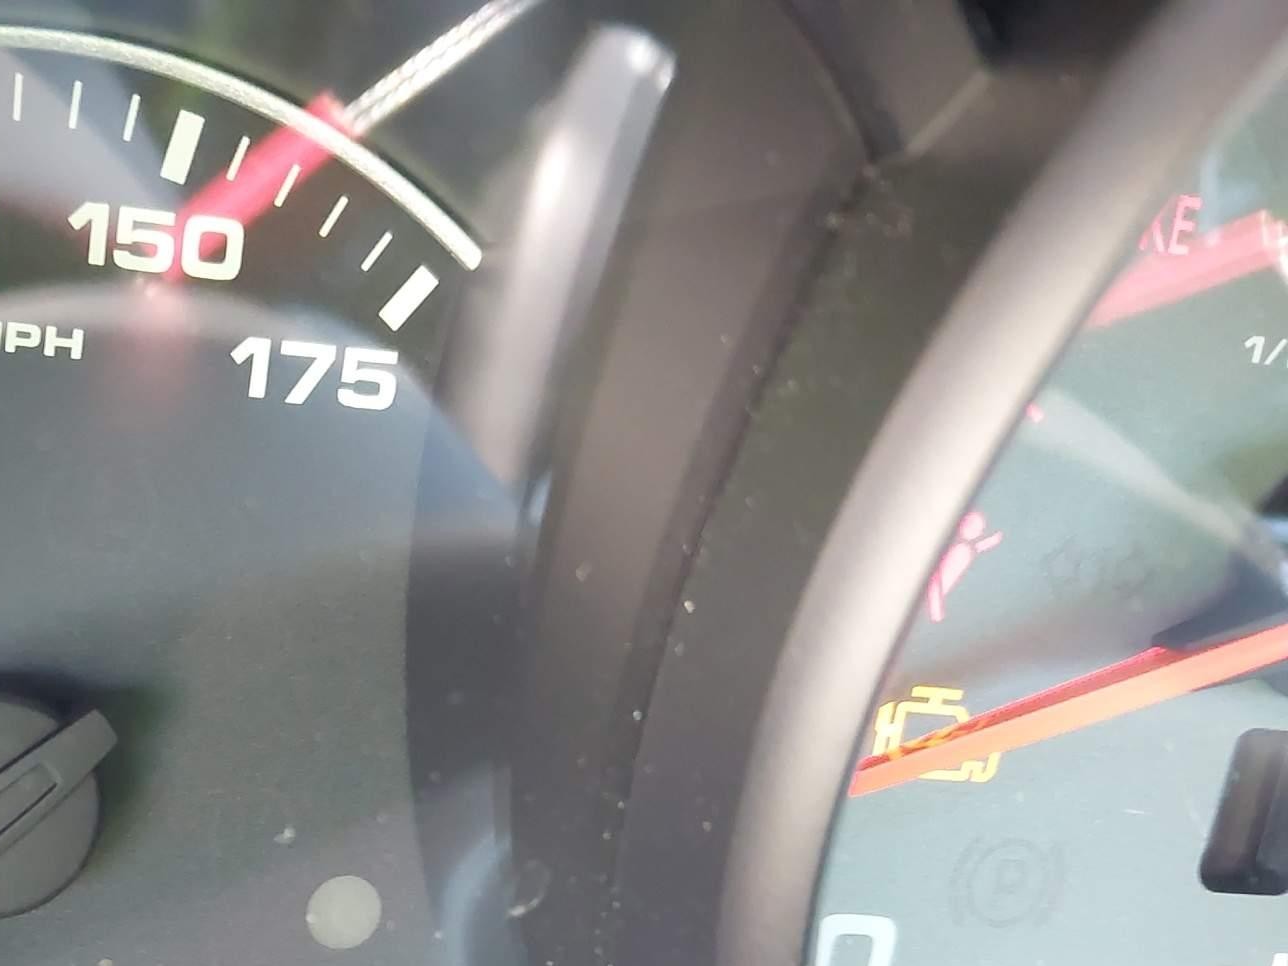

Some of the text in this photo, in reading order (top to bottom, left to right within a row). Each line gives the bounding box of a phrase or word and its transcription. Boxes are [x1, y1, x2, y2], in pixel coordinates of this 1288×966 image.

[67, 202, 245, 281] 150
[230, 337, 399, 411] 175
[1244, 335, 1288, 366] 1/
